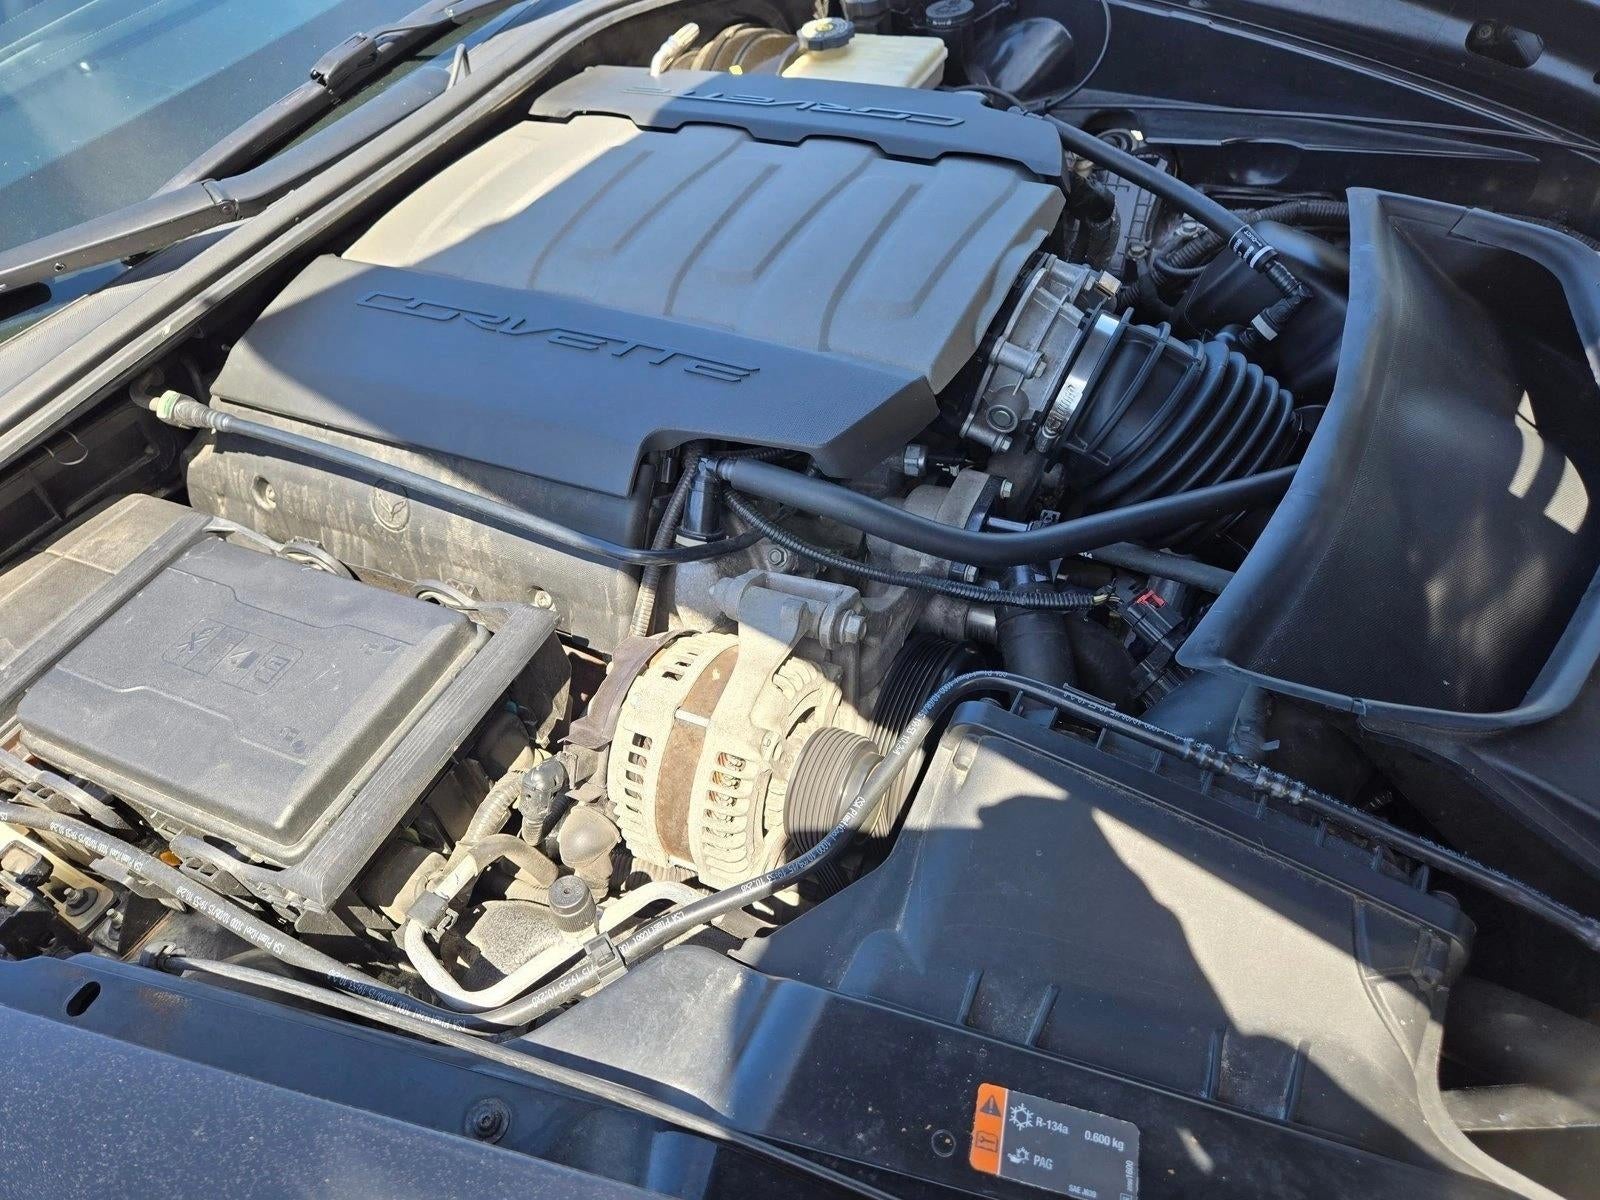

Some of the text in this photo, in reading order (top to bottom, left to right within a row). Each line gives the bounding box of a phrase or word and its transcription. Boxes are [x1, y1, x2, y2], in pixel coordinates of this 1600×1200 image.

[620, 87, 965, 126] CORVETTE
[356, 293, 760, 382] CORVETTE
[853, 796, 866, 809] CSA
[672, 911, 686, 925] CSA
[273, 941, 286, 955] CSA
[559, 973, 581, 991] 19:53
[1036, 1116, 1069, 1135] R-134a
[1084, 1130, 1125, 1152] 0.600 kg
[1033, 1154, 1054, 1170] PAG
